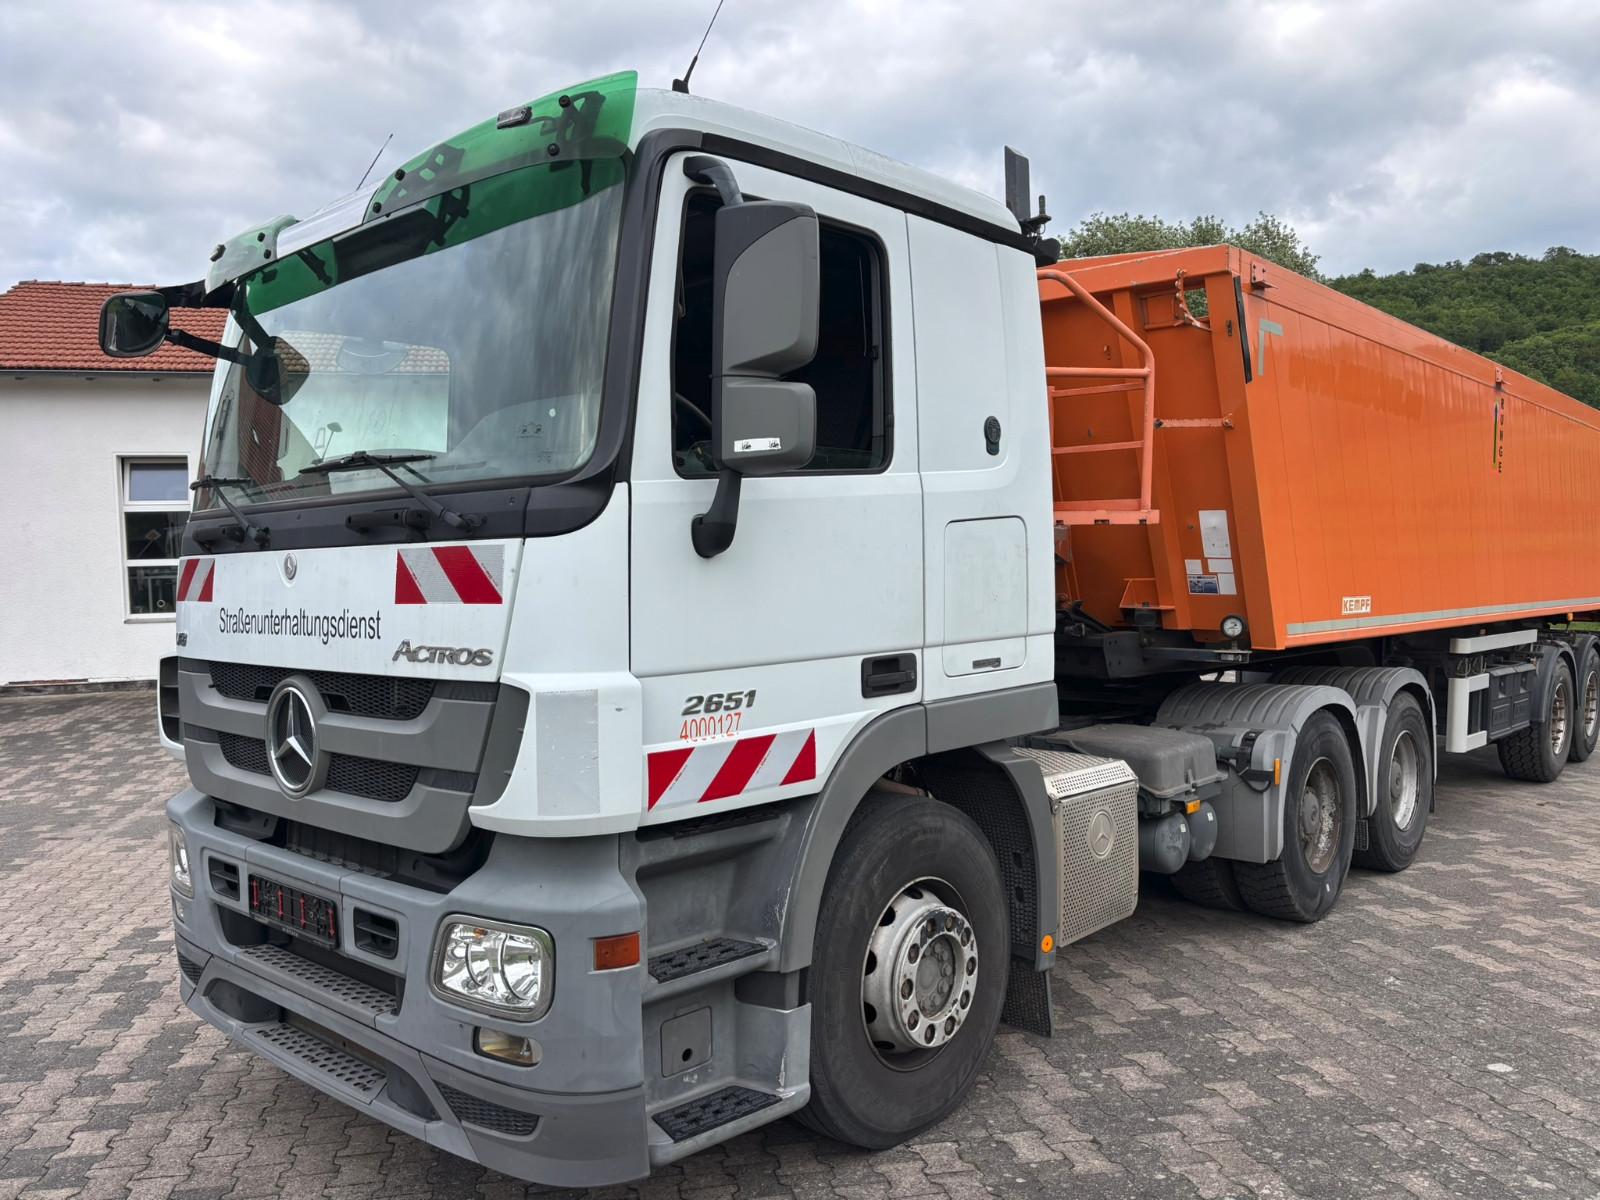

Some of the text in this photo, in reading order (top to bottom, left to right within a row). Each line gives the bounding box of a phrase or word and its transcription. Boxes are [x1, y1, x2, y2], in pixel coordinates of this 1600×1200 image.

[219, 607, 381, 645] Straßenunterhaltungsdienst
[681, 689, 757, 716] 2651
[680, 711, 742, 742] 4000127
